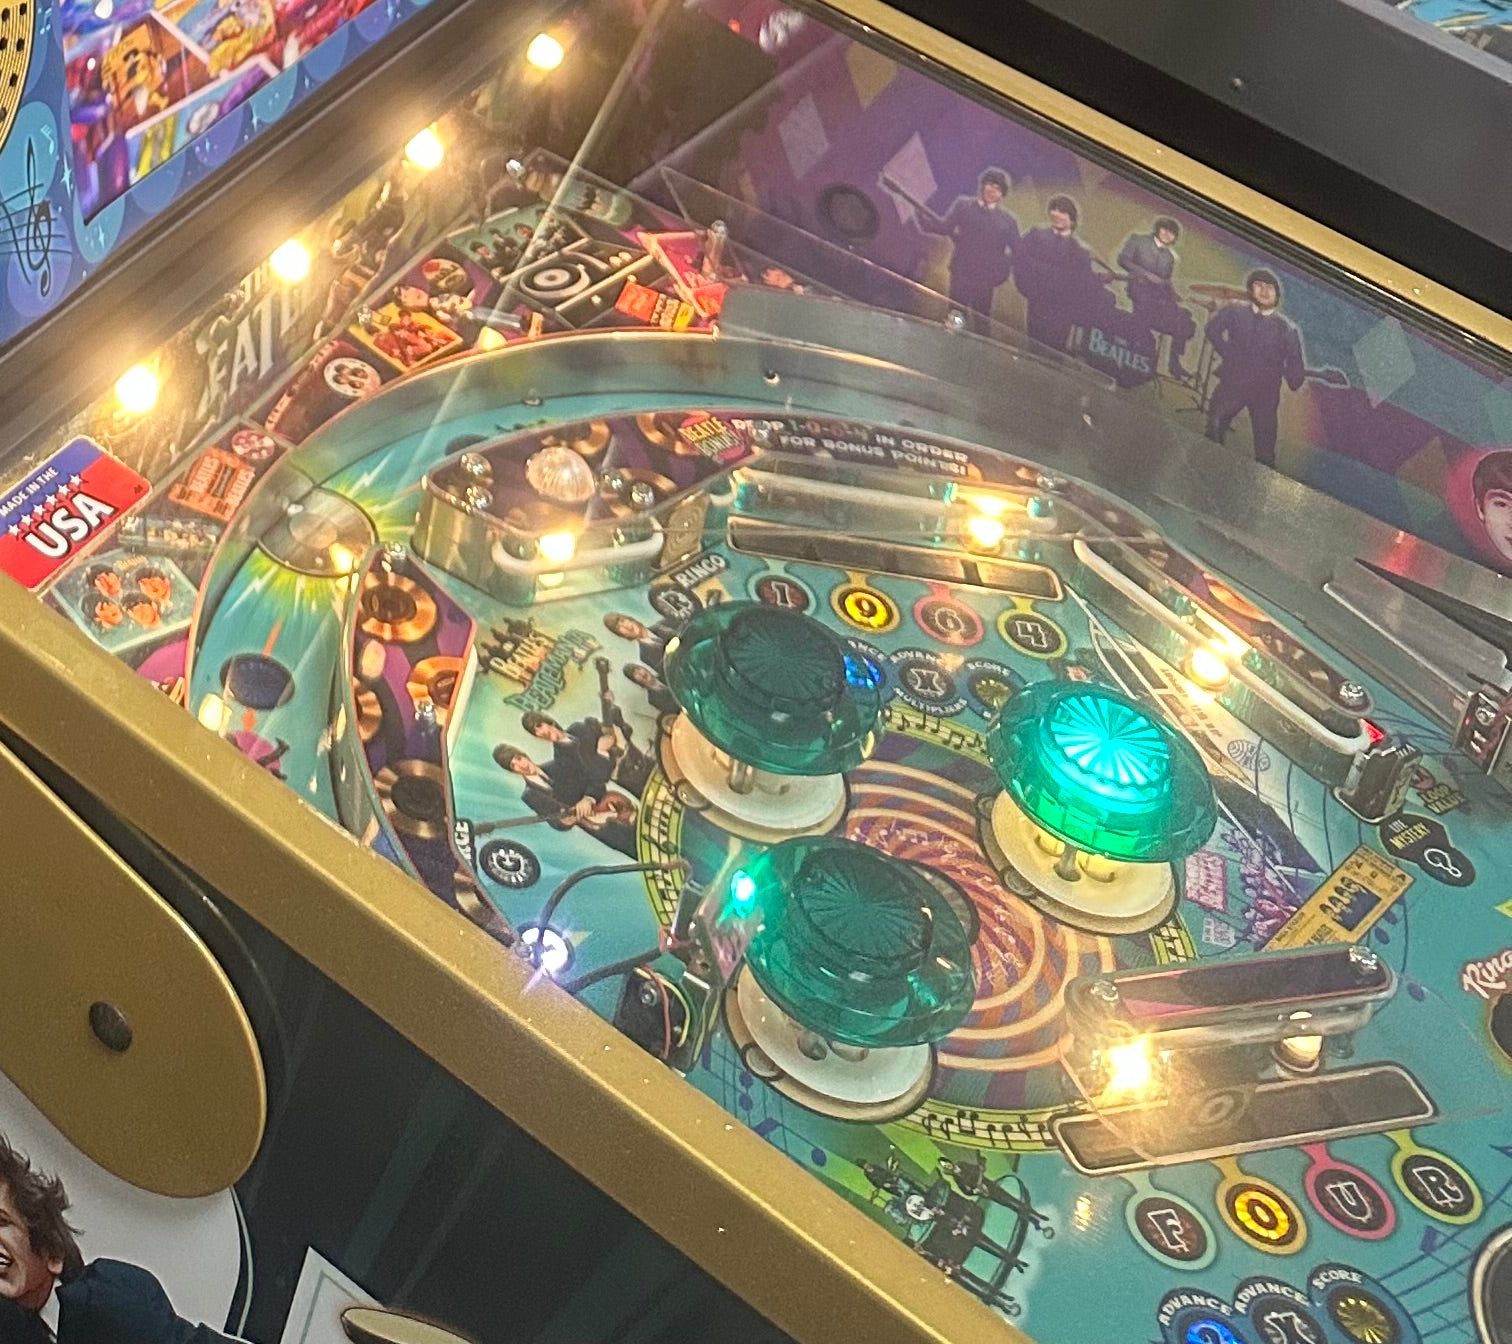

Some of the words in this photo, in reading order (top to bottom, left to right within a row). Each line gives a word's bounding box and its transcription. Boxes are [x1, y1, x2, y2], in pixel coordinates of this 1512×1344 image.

[823, 438, 885, 459] BONUS
[876, 433, 896, 446] IN
[901, 439, 969, 463] ORDER
[27, 483, 41, 498] IN
[38, 466, 60, 487] THE
[24, 492, 116, 559] USA
[674, 553, 726, 589] RINGO
[966, 661, 1012, 677] SCORE
[1389, 822, 1431, 850] MYSTERY
[1147, 1208, 1190, 1253] F
[1235, 1190, 1290, 1241] O
[1326, 1181, 1372, 1223] U
[1412, 1165, 1465, 1208] R
[1312, 1269, 1362, 1290] SCORE
[1157, 1295, 1233, 1326] ADVANCE
[1234, 1282, 1310, 1314] ADVANCE
